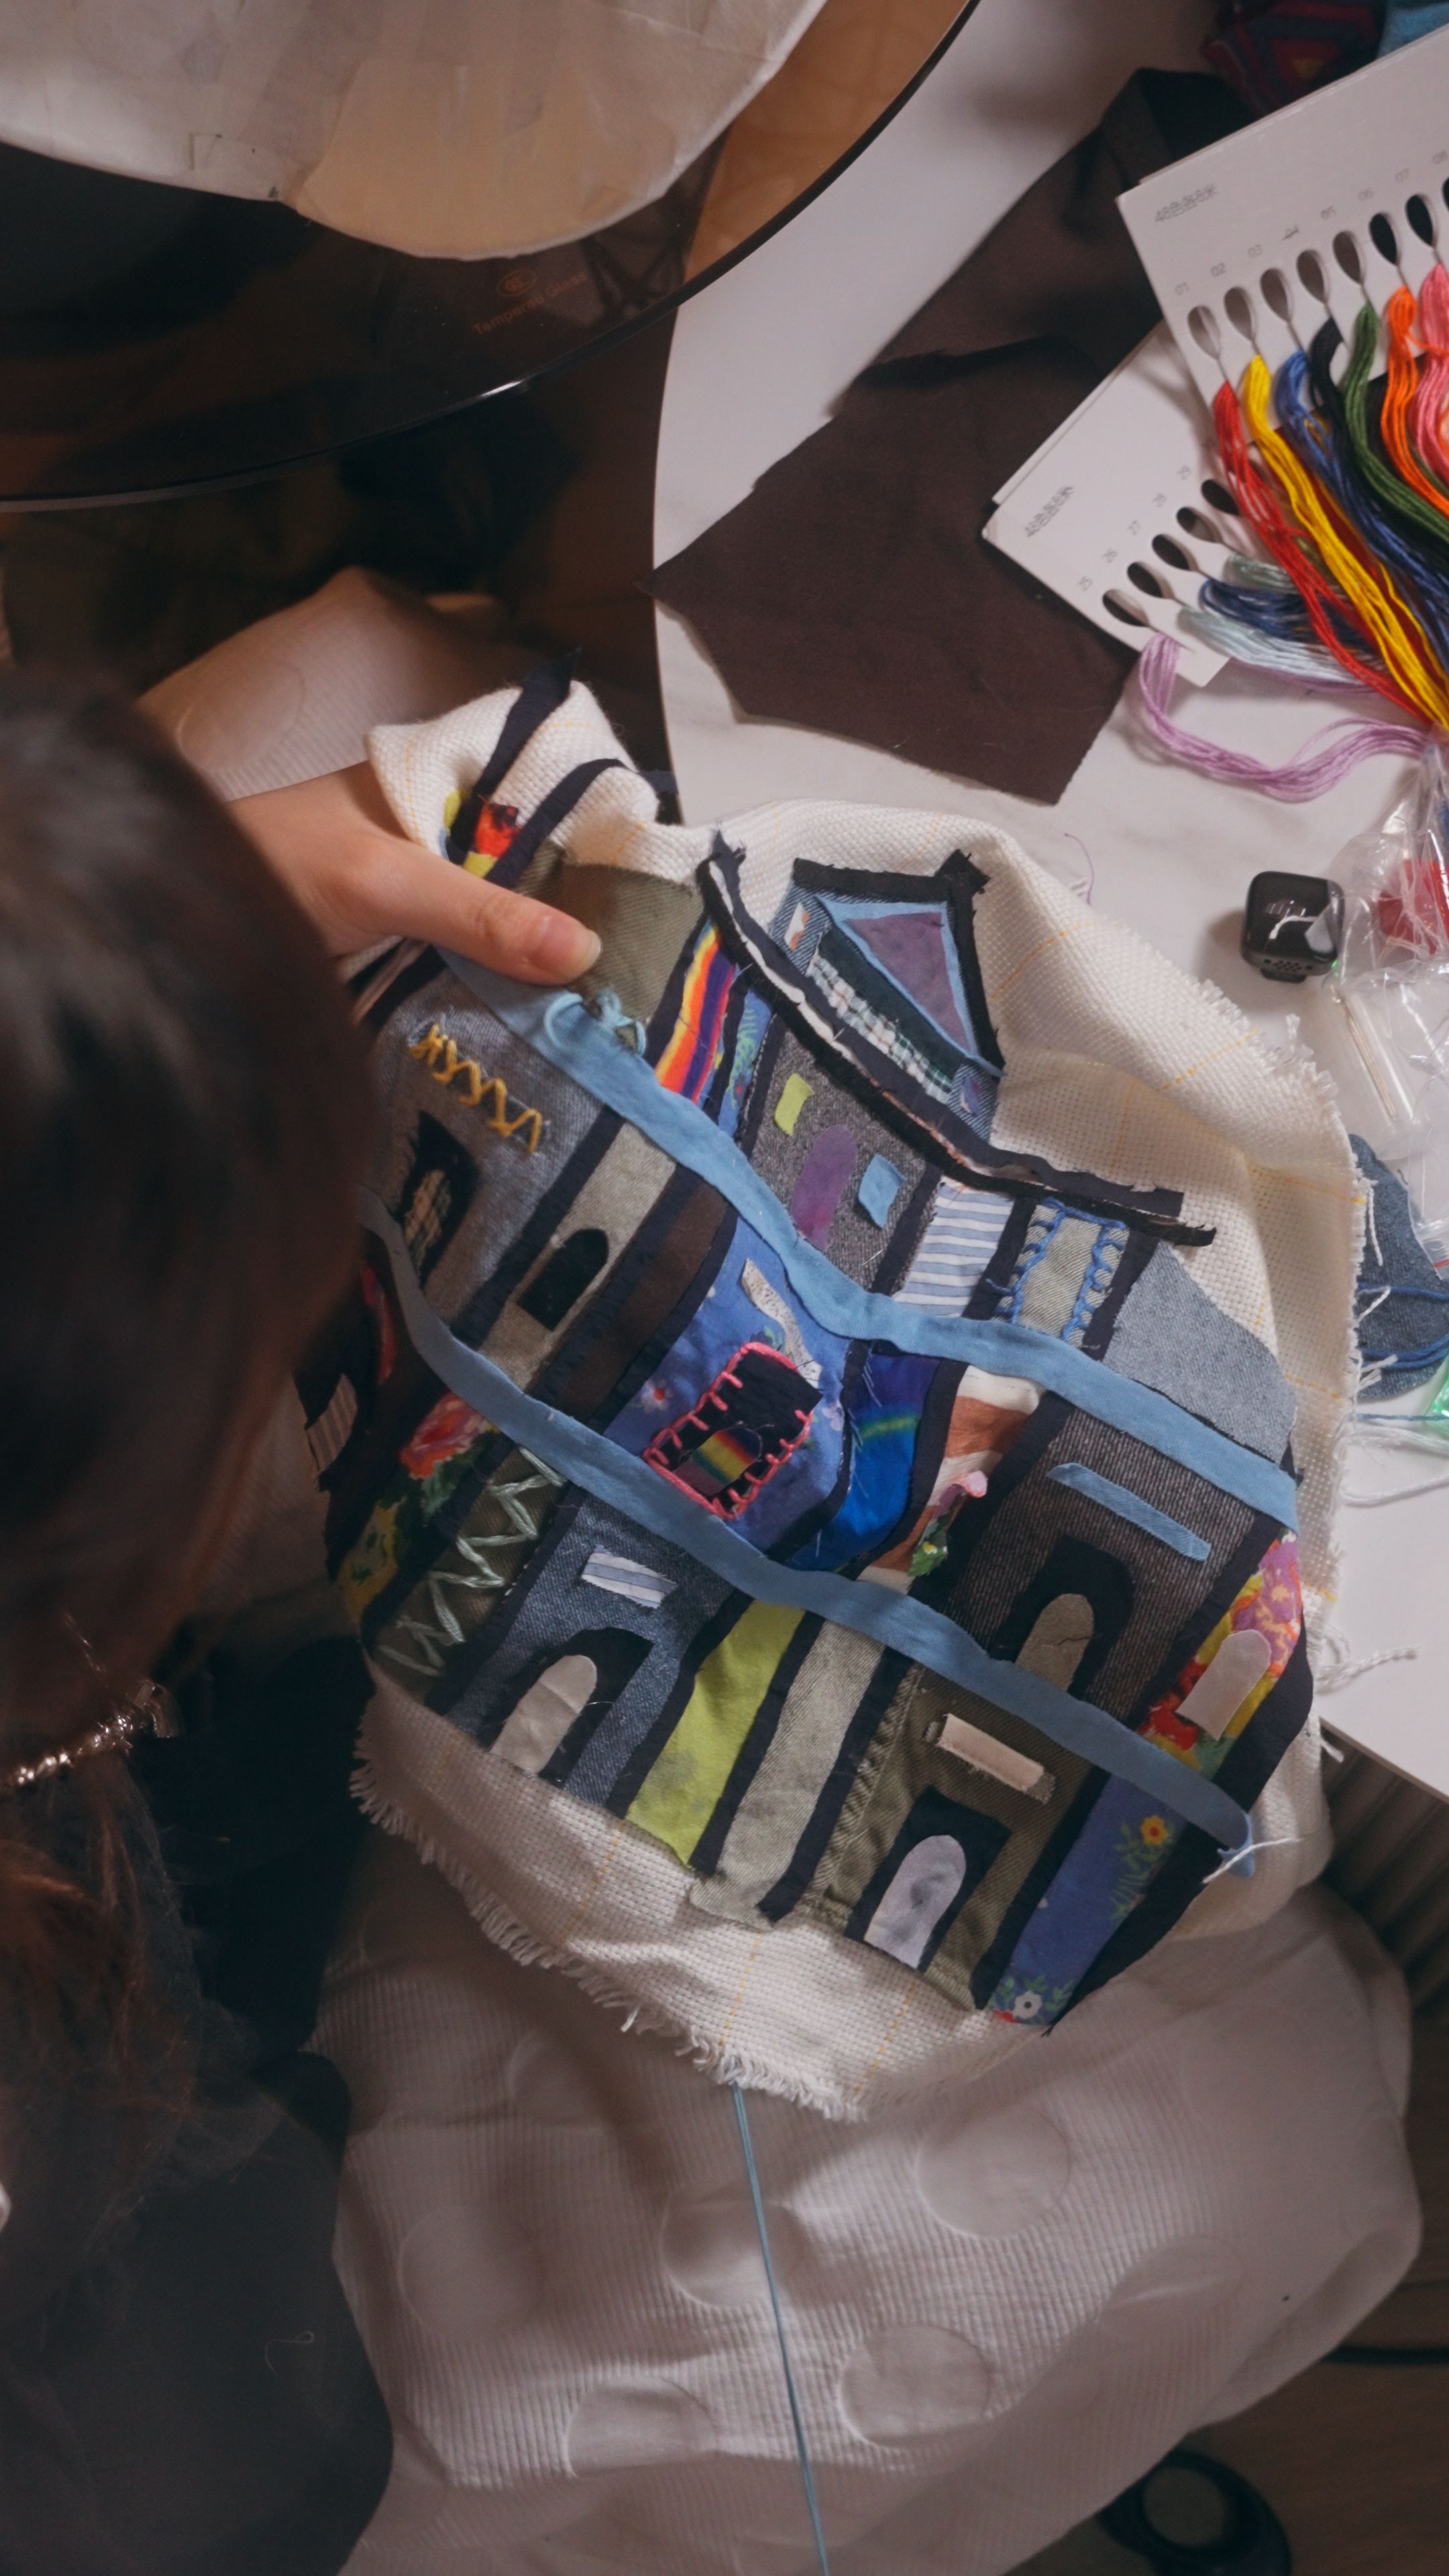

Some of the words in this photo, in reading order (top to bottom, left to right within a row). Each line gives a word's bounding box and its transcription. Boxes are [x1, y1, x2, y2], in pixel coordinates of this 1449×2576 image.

[1211, 262, 1226, 277] 02
[472, 296, 543, 334] Tempered
[545, 270, 588, 298] Glass
